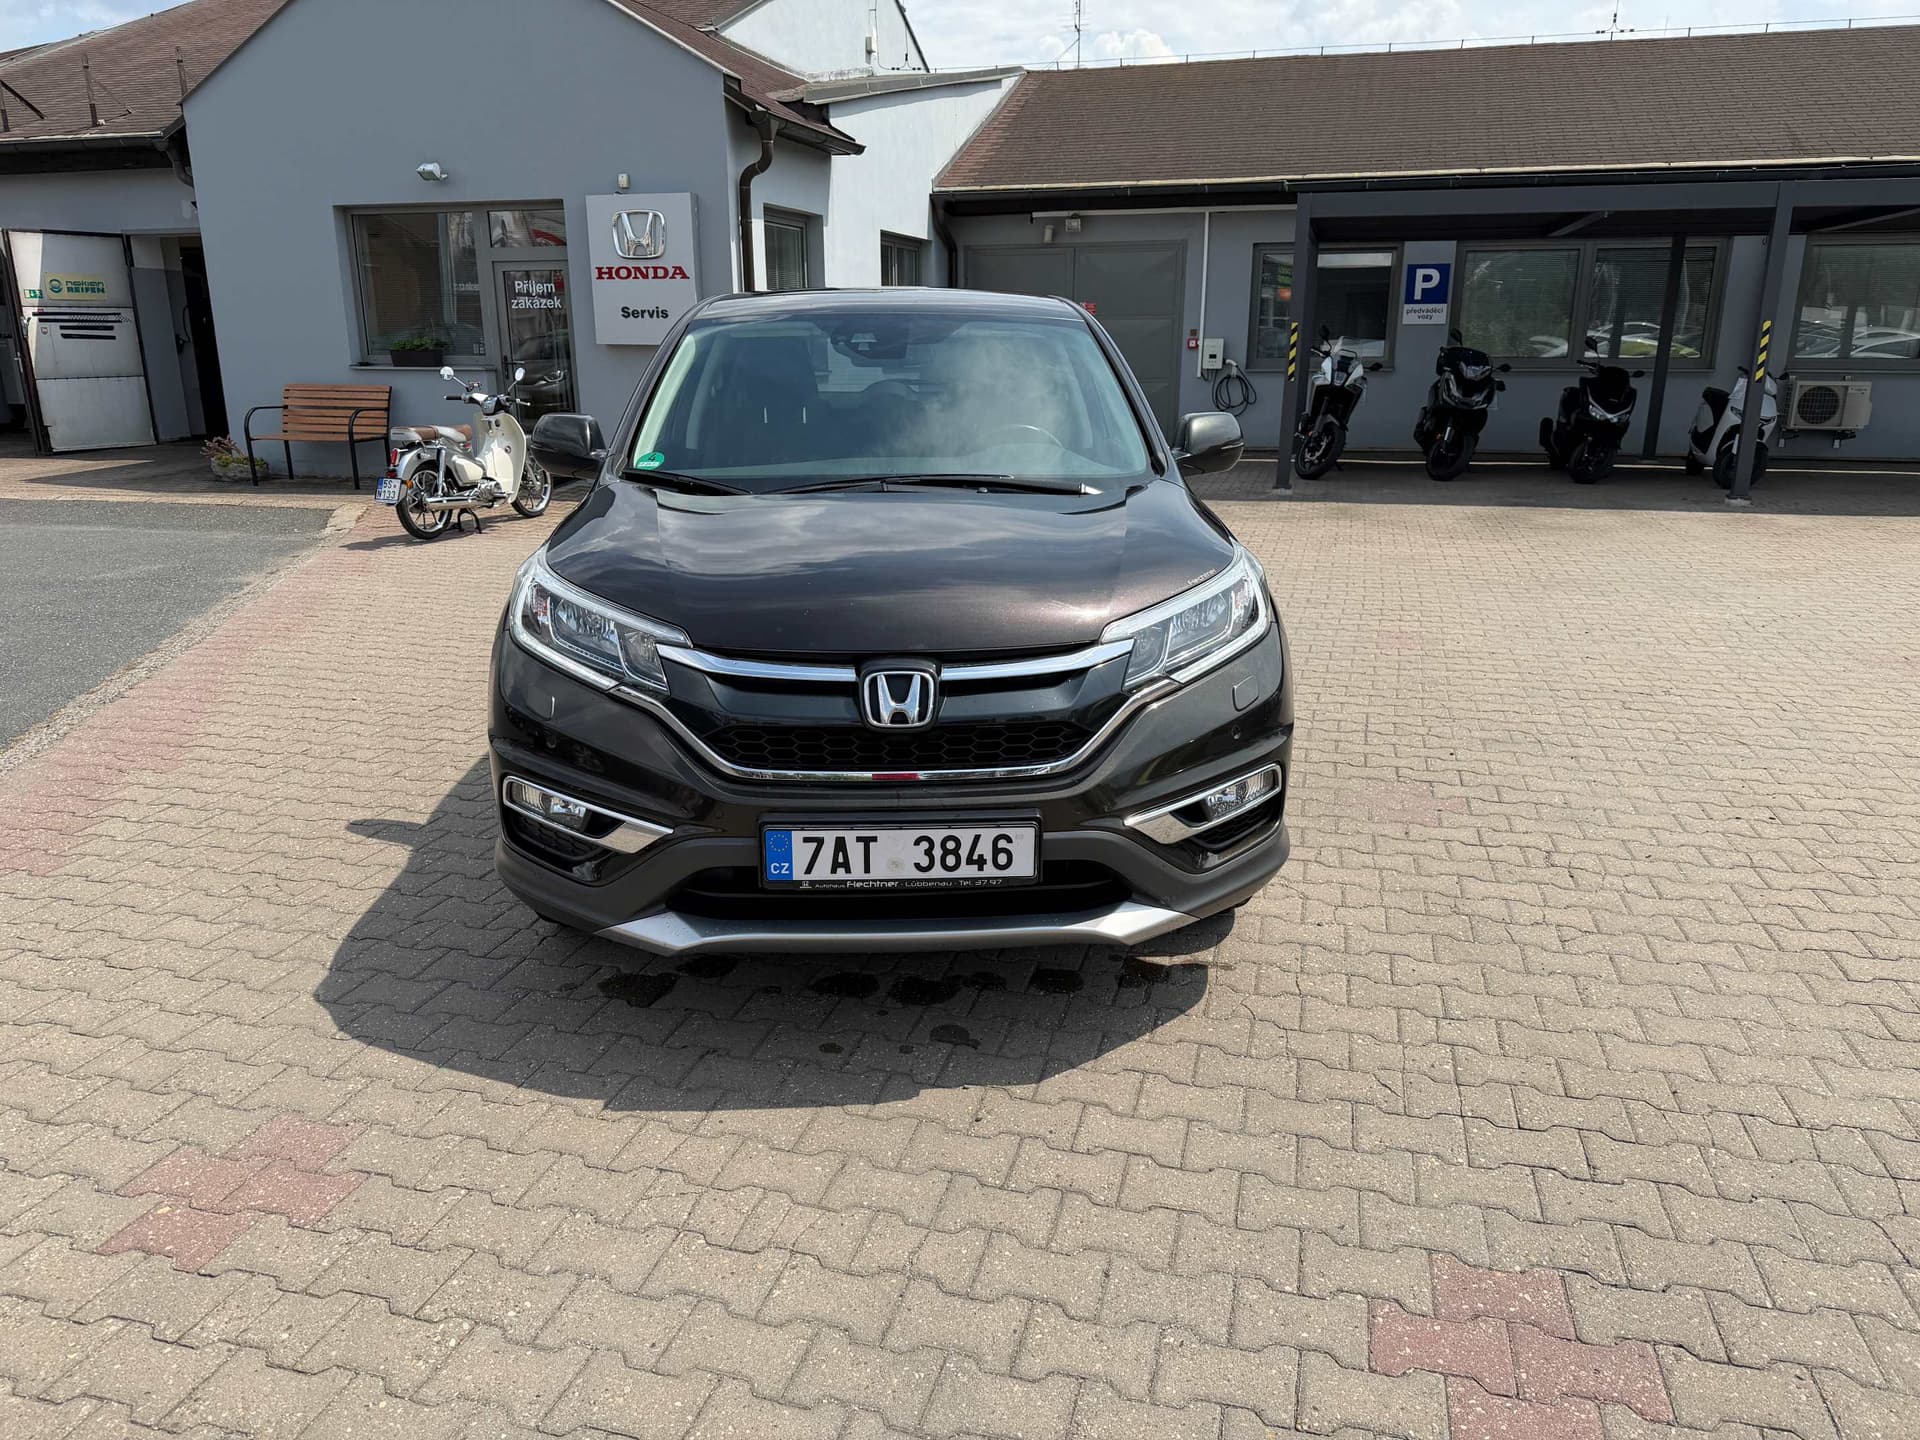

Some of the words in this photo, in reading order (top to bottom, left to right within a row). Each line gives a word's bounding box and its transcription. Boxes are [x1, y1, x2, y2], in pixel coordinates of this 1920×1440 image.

[595, 266, 690, 280] HONDA
[66, 286, 105, 294] REIFEN
[514, 280, 556, 296] Příjem
[1414, 268, 1440, 300] P
[511, 295, 562, 309] zakázek
[621, 306, 669, 319] Servis
[647, 452, 657, 462] 4
[383, 479, 393, 489] 5S
[802, 836, 878, 875] 7AT
[913, 834, 1014, 873] 3846
[770, 863, 790, 874] CZ
